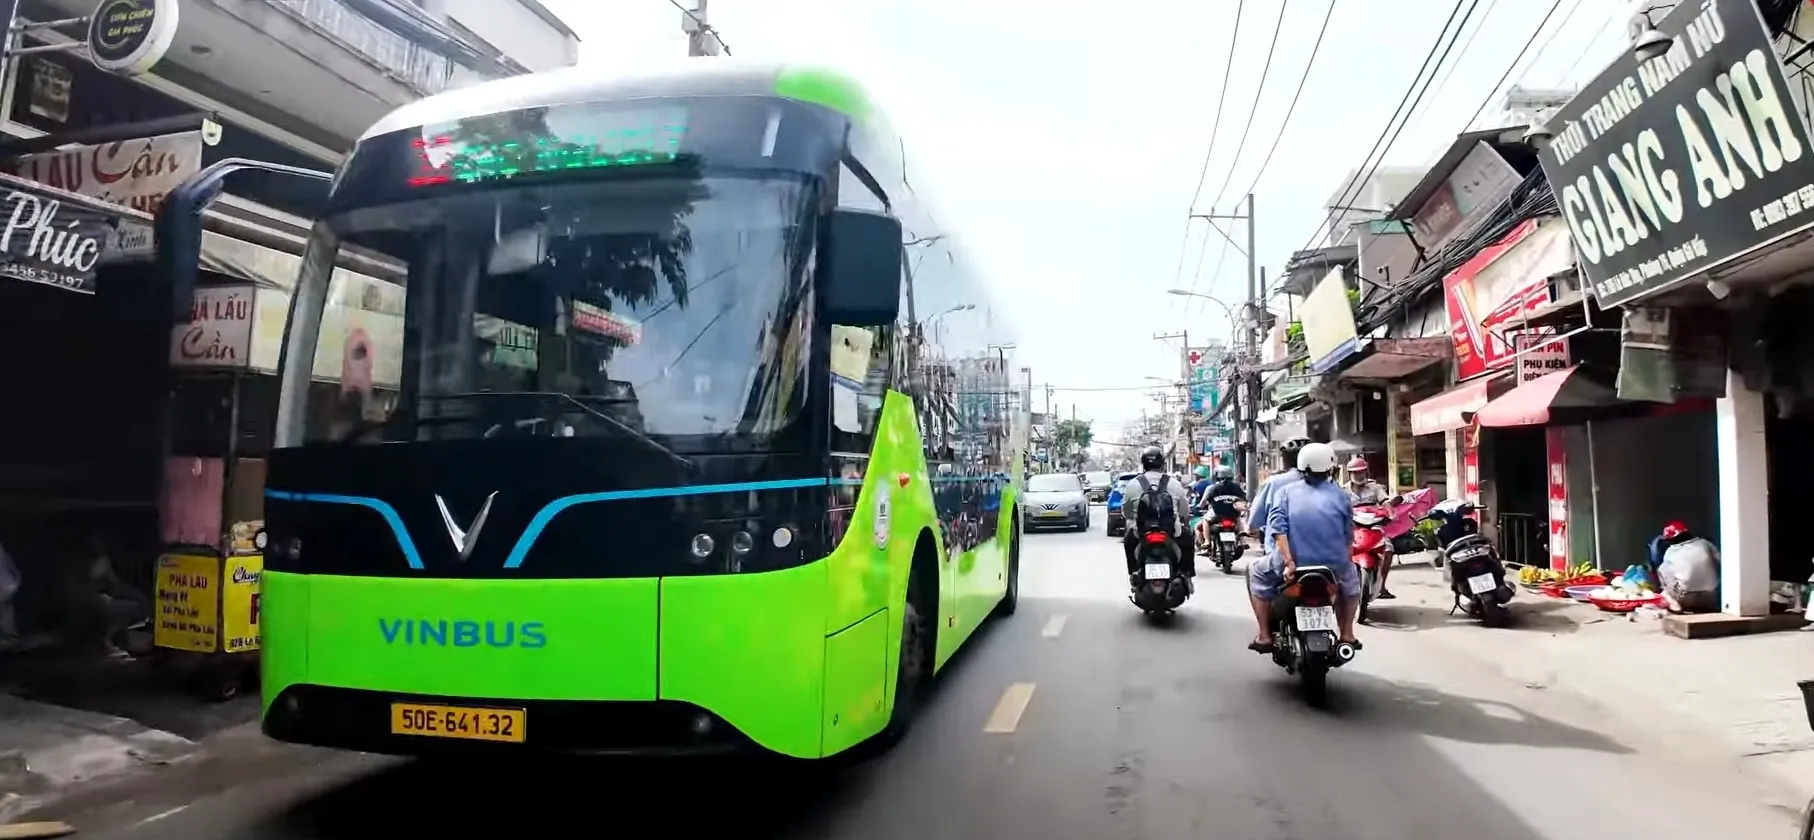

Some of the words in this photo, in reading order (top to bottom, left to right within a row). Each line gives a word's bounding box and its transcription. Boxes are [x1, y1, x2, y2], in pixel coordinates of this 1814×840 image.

[1581, 76, 1644, 140] TRANG
[1637, 34, 1693, 98] NAM
[1562, 128, 1683, 264] GIANG
[1675, 49, 1802, 208] ANH
[0, 191, 100, 272] Phúc
[1547, 342, 1564, 353] PIN
[379, 618, 547, 649] VINBUS
[402, 709, 513, 736] 50E-641.32
